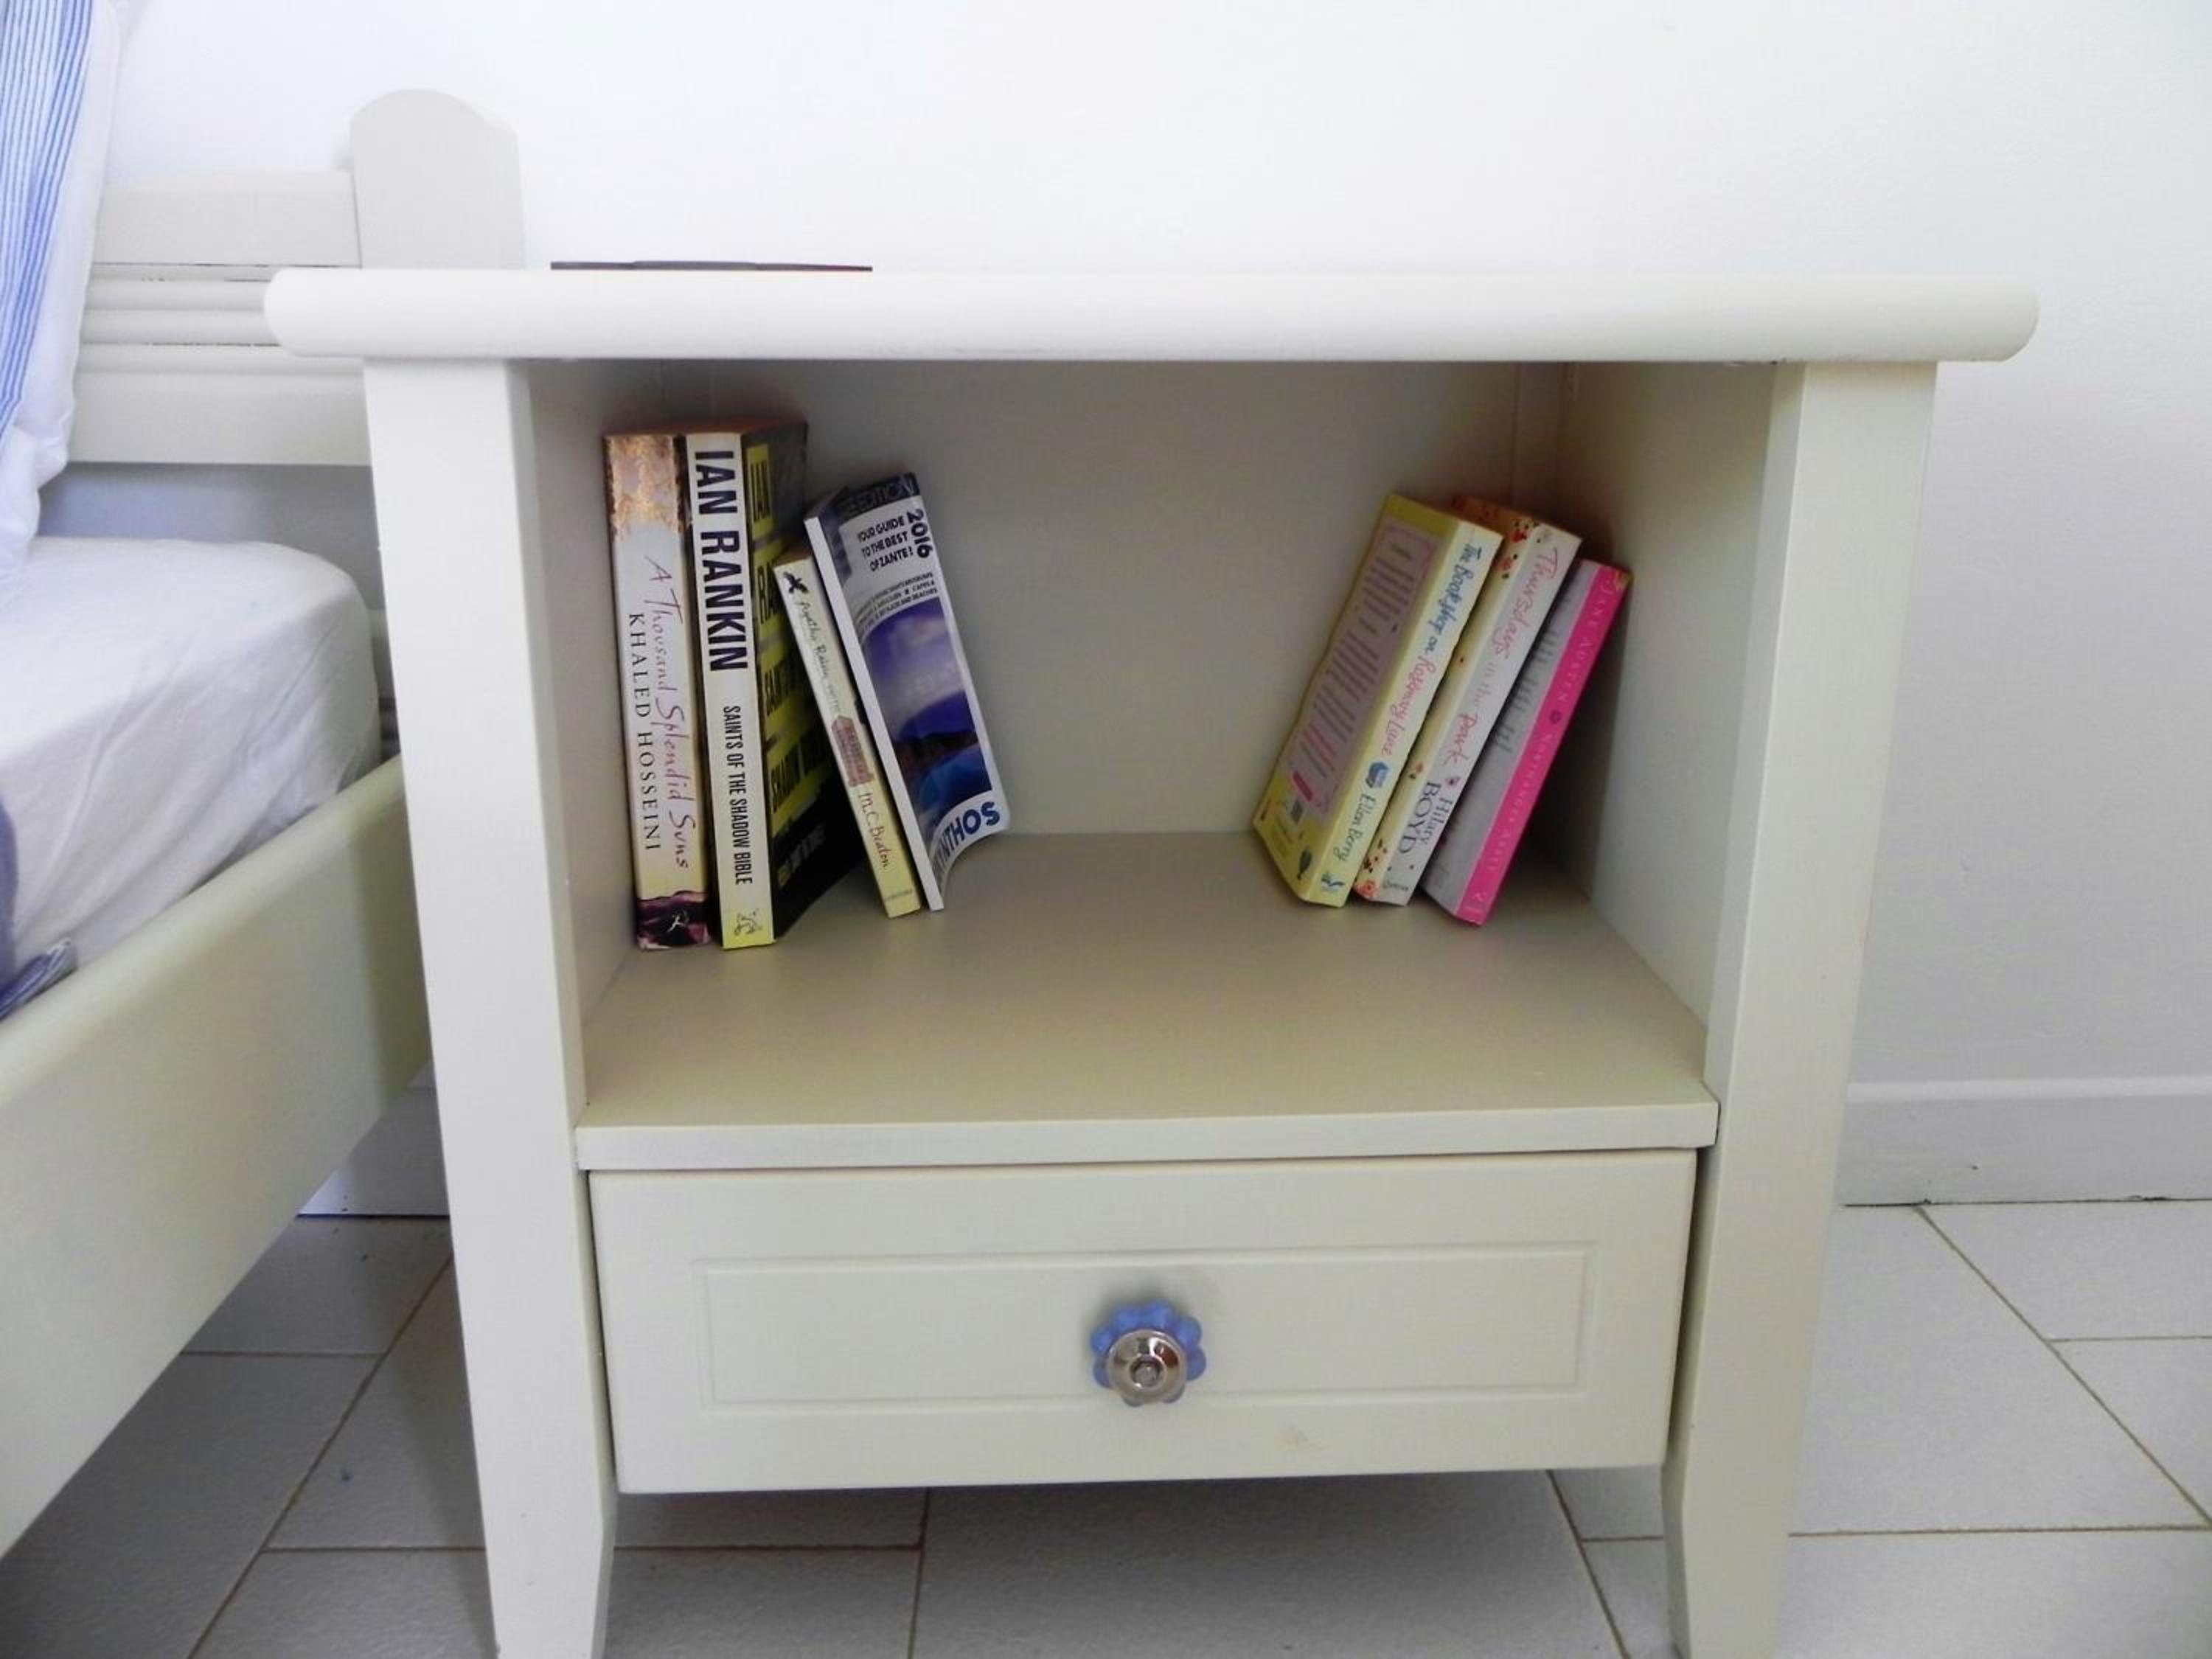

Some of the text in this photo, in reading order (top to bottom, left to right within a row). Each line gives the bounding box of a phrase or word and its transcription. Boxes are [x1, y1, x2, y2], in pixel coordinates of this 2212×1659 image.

[871, 539, 885, 555] THE
[885, 530, 908, 548] BEST
[876, 515, 905, 534] GUIDE
[906, 508, 933, 559] 2016
[695, 451, 748, 672] IAN RANKIN
[1427, 563, 1474, 636] Bookshop
[1490, 547, 1559, 660] Thursdays
[628, 613, 663, 851] KHALED HOSSEINI
[644, 554, 696, 869] A Thousand Splendid Suns
[723, 706, 753, 886] SAINTS OF THE SHADOW BIBLE
[1398, 781, 1441, 854] BOYD
[1420, 796, 1453, 846] Hilary
[1333, 821, 1363, 862] Berry
